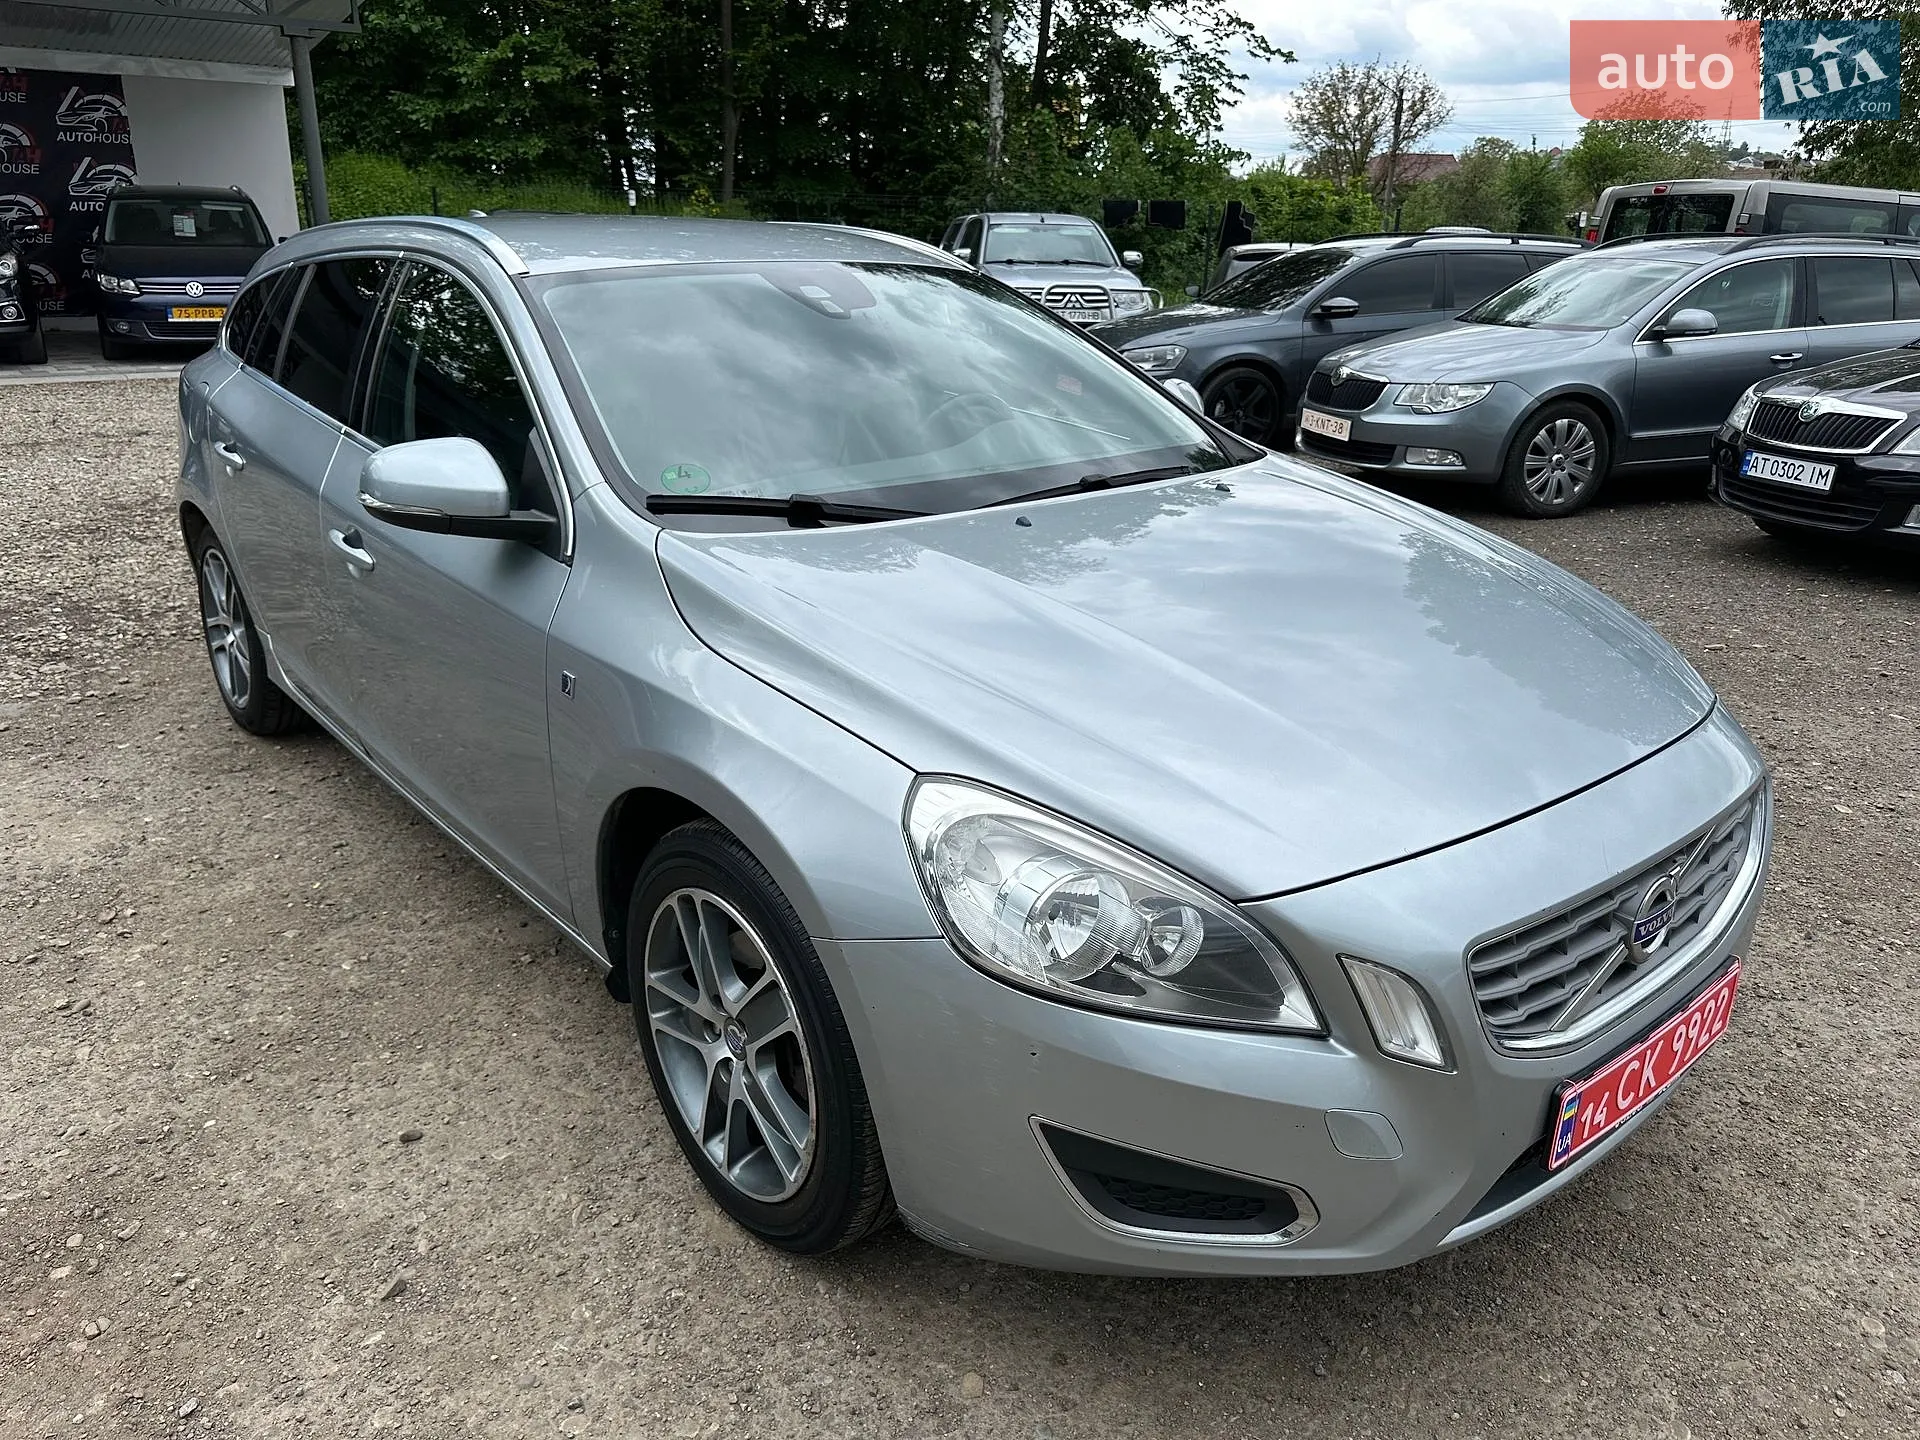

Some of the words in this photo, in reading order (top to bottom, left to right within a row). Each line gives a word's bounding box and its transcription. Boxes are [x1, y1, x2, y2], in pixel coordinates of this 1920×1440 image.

[37, 301, 65, 312] USE
[1749, 456, 1771, 474] AT
[1769, 460, 1805, 482] 0302
[1808, 466, 1831, 487] IM
[1580, 1090, 1610, 1140] 14
[1616, 1039, 1664, 1111] CK
[1668, 986, 1730, 1075] 9922
[1557, 1135, 1572, 1153] UA
